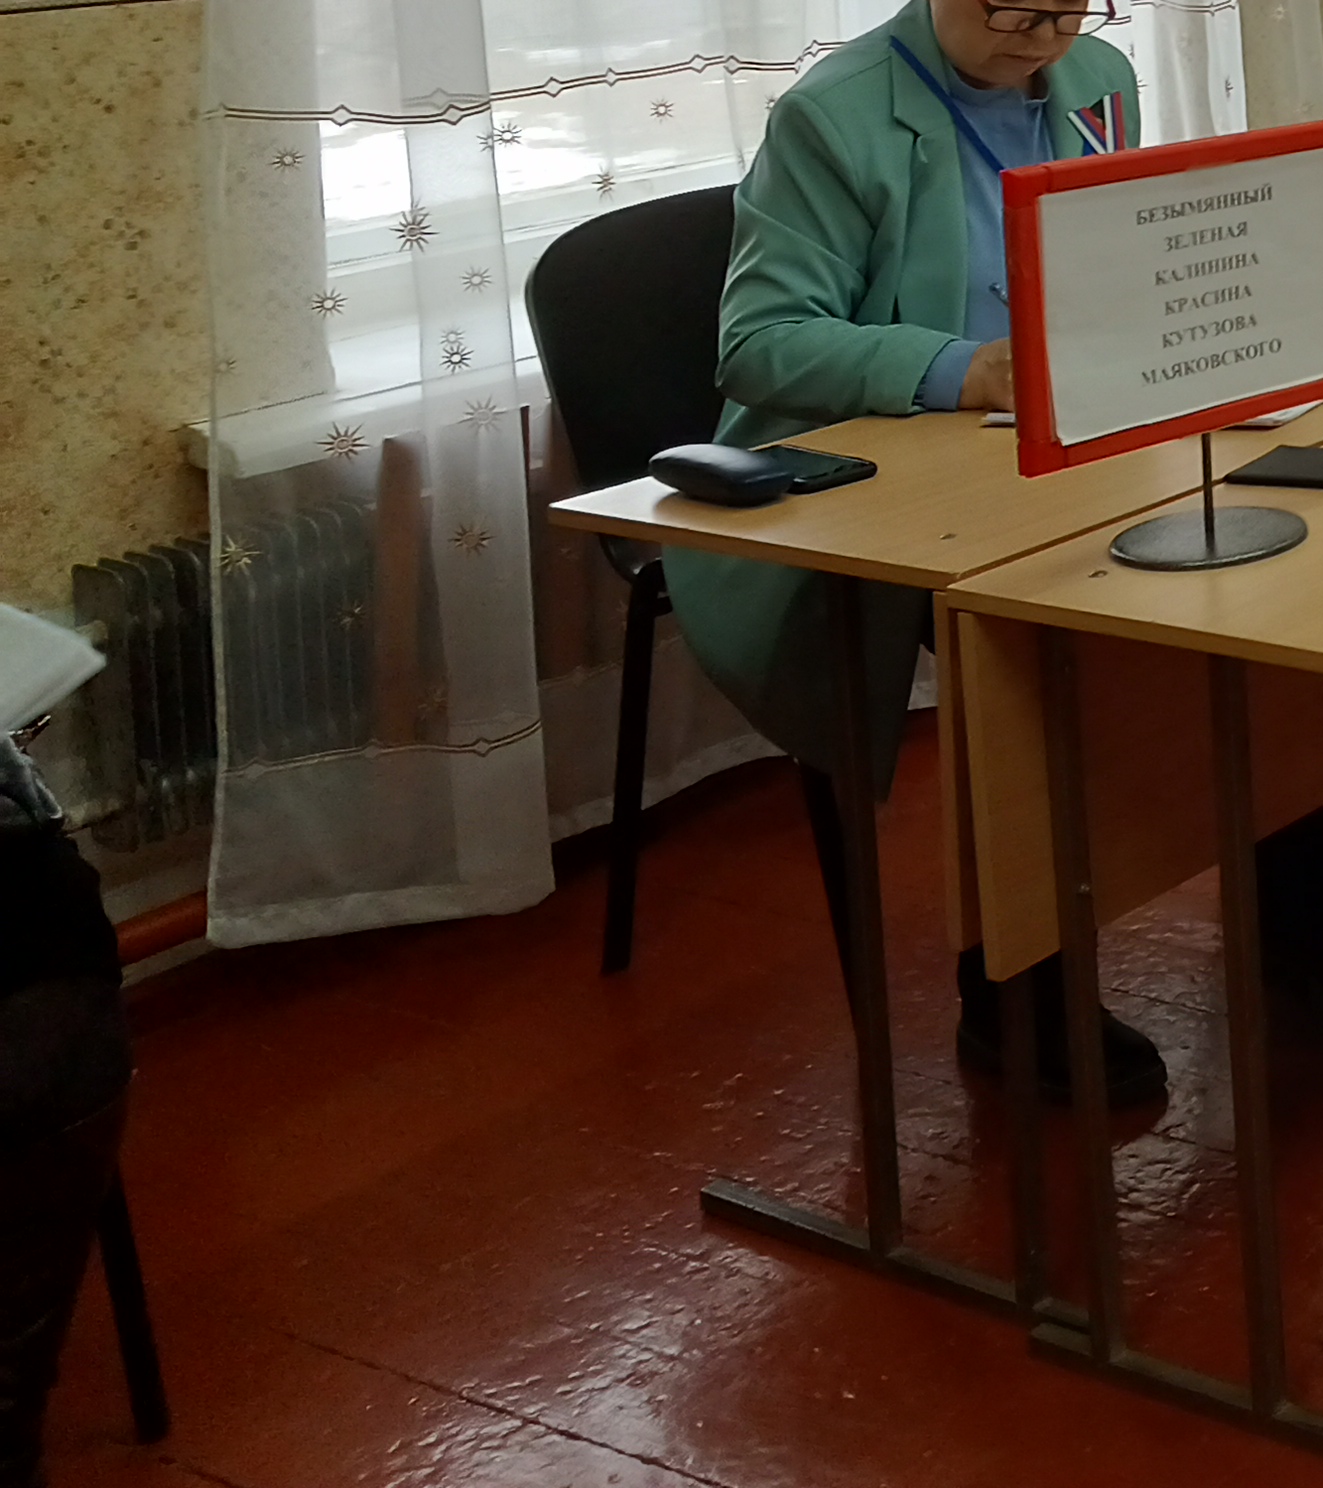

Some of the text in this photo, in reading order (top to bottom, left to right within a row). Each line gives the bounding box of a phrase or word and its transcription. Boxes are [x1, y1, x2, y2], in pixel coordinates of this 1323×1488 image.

[1136, 183, 1273, 226] БЕЗЫМЯННЫЙ
[1163, 221, 1248, 253] ЗЕЛЕНАЯ
[1154, 252, 1260, 287] КАЛИНИНА
[1164, 283, 1253, 316] КРАСИНА
[1161, 313, 1258, 349] КУТУЗОВА
[1141, 337, 1283, 386] МАЯКОВСКОГО
